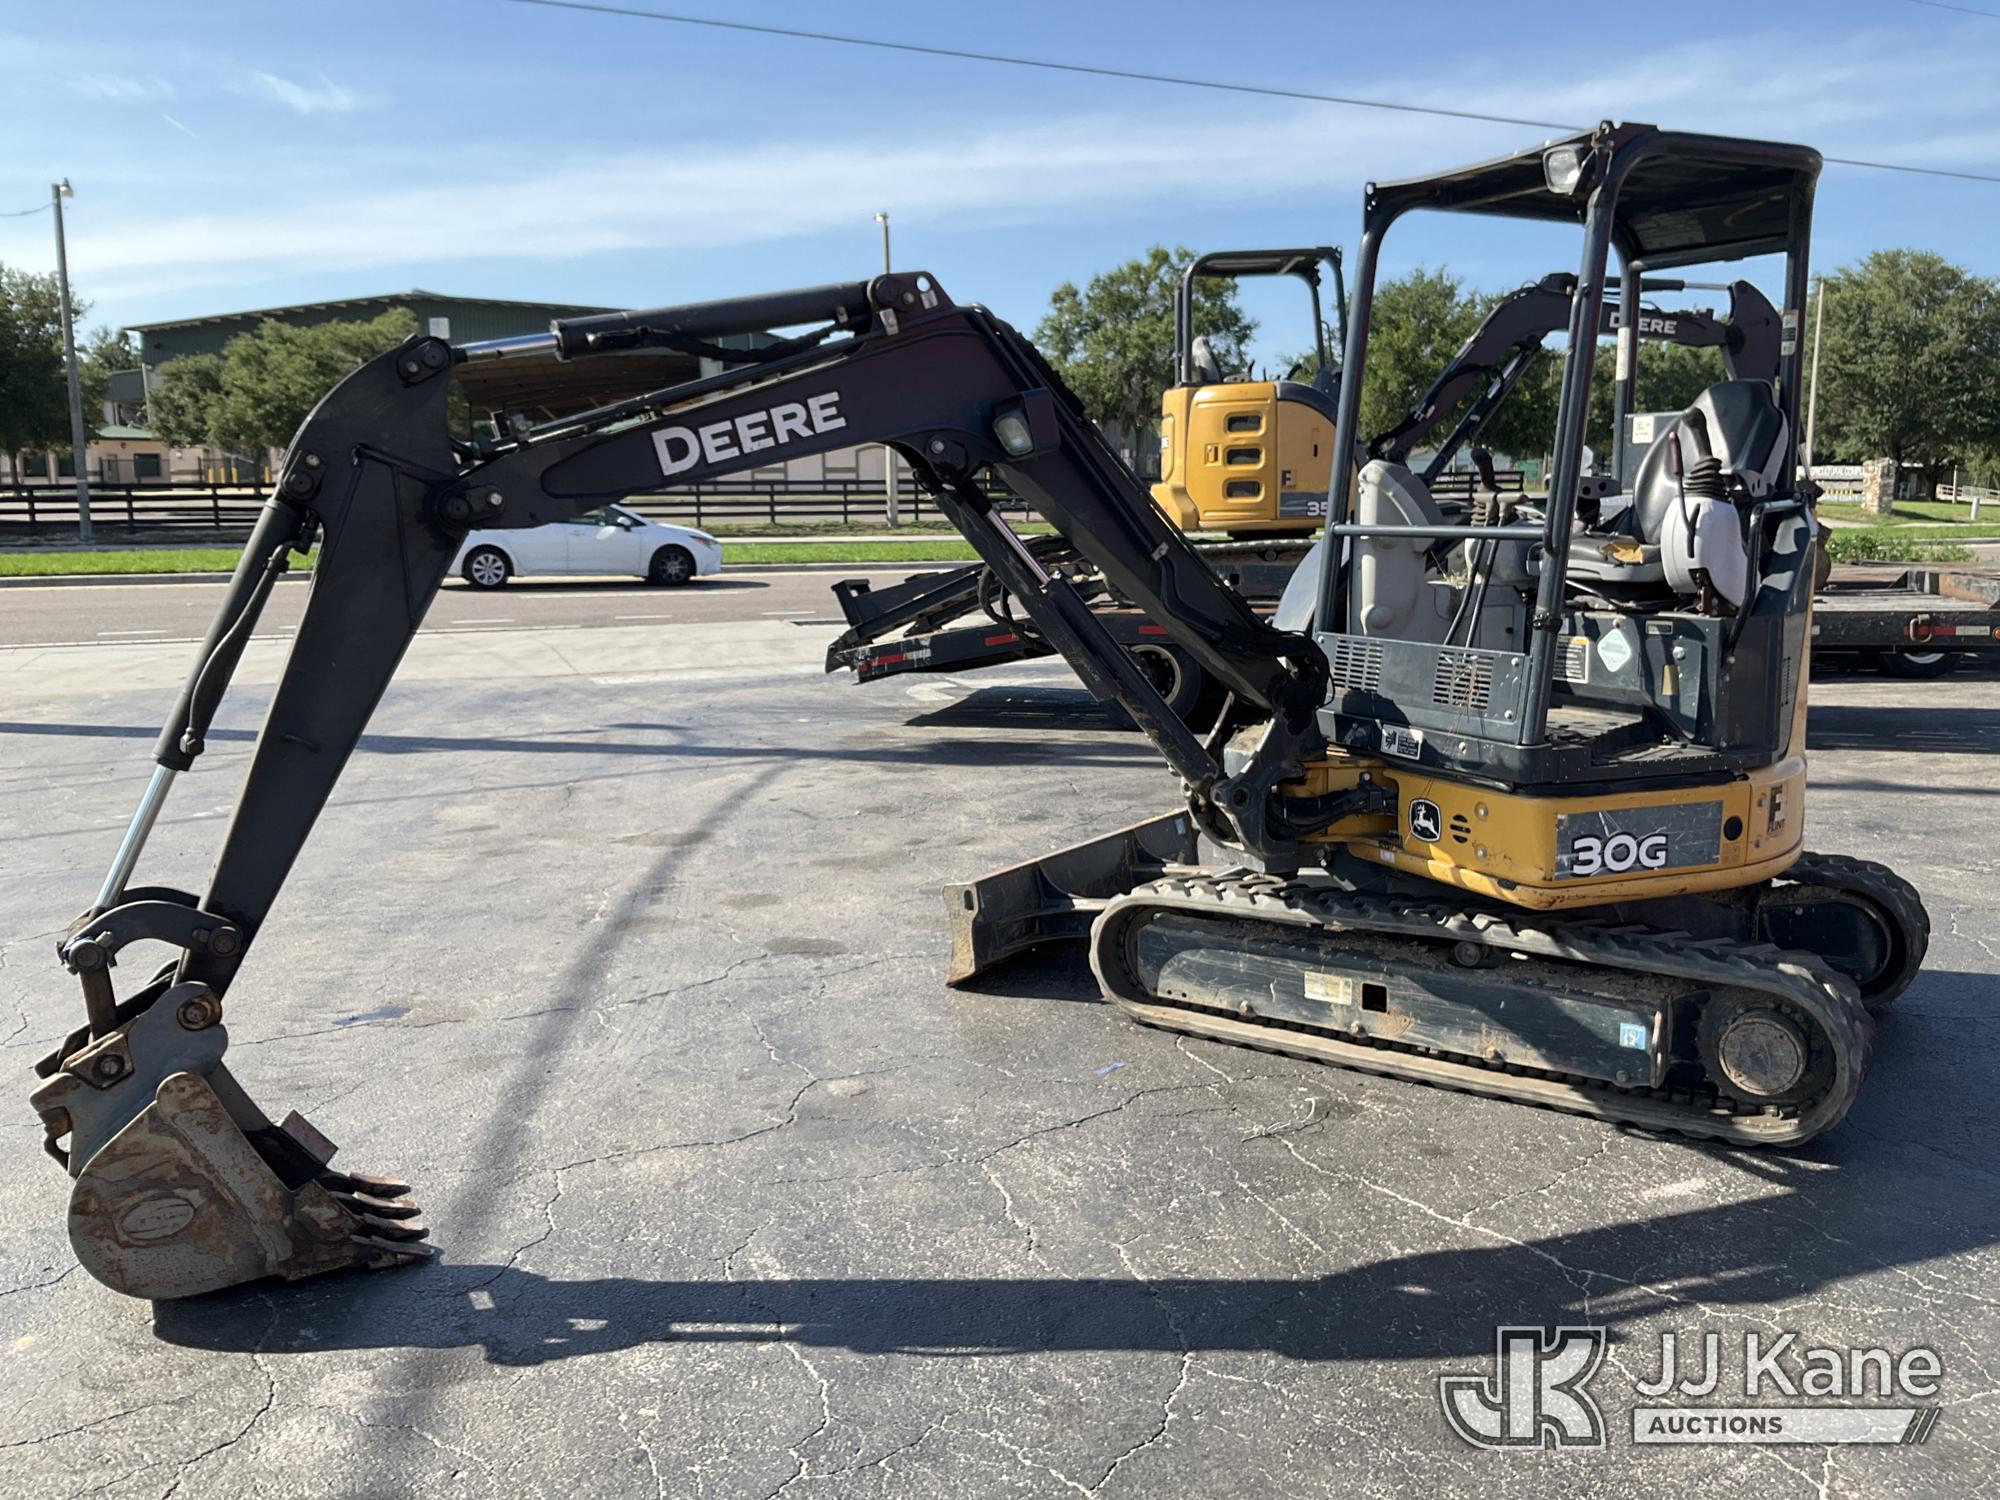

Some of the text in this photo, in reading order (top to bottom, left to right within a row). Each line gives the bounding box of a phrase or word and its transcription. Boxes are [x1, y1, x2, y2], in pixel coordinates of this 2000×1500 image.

[1609, 312, 1677, 334] DERE
[651, 391, 847, 476] DEERE
[1572, 833, 1667, 876] 30G
